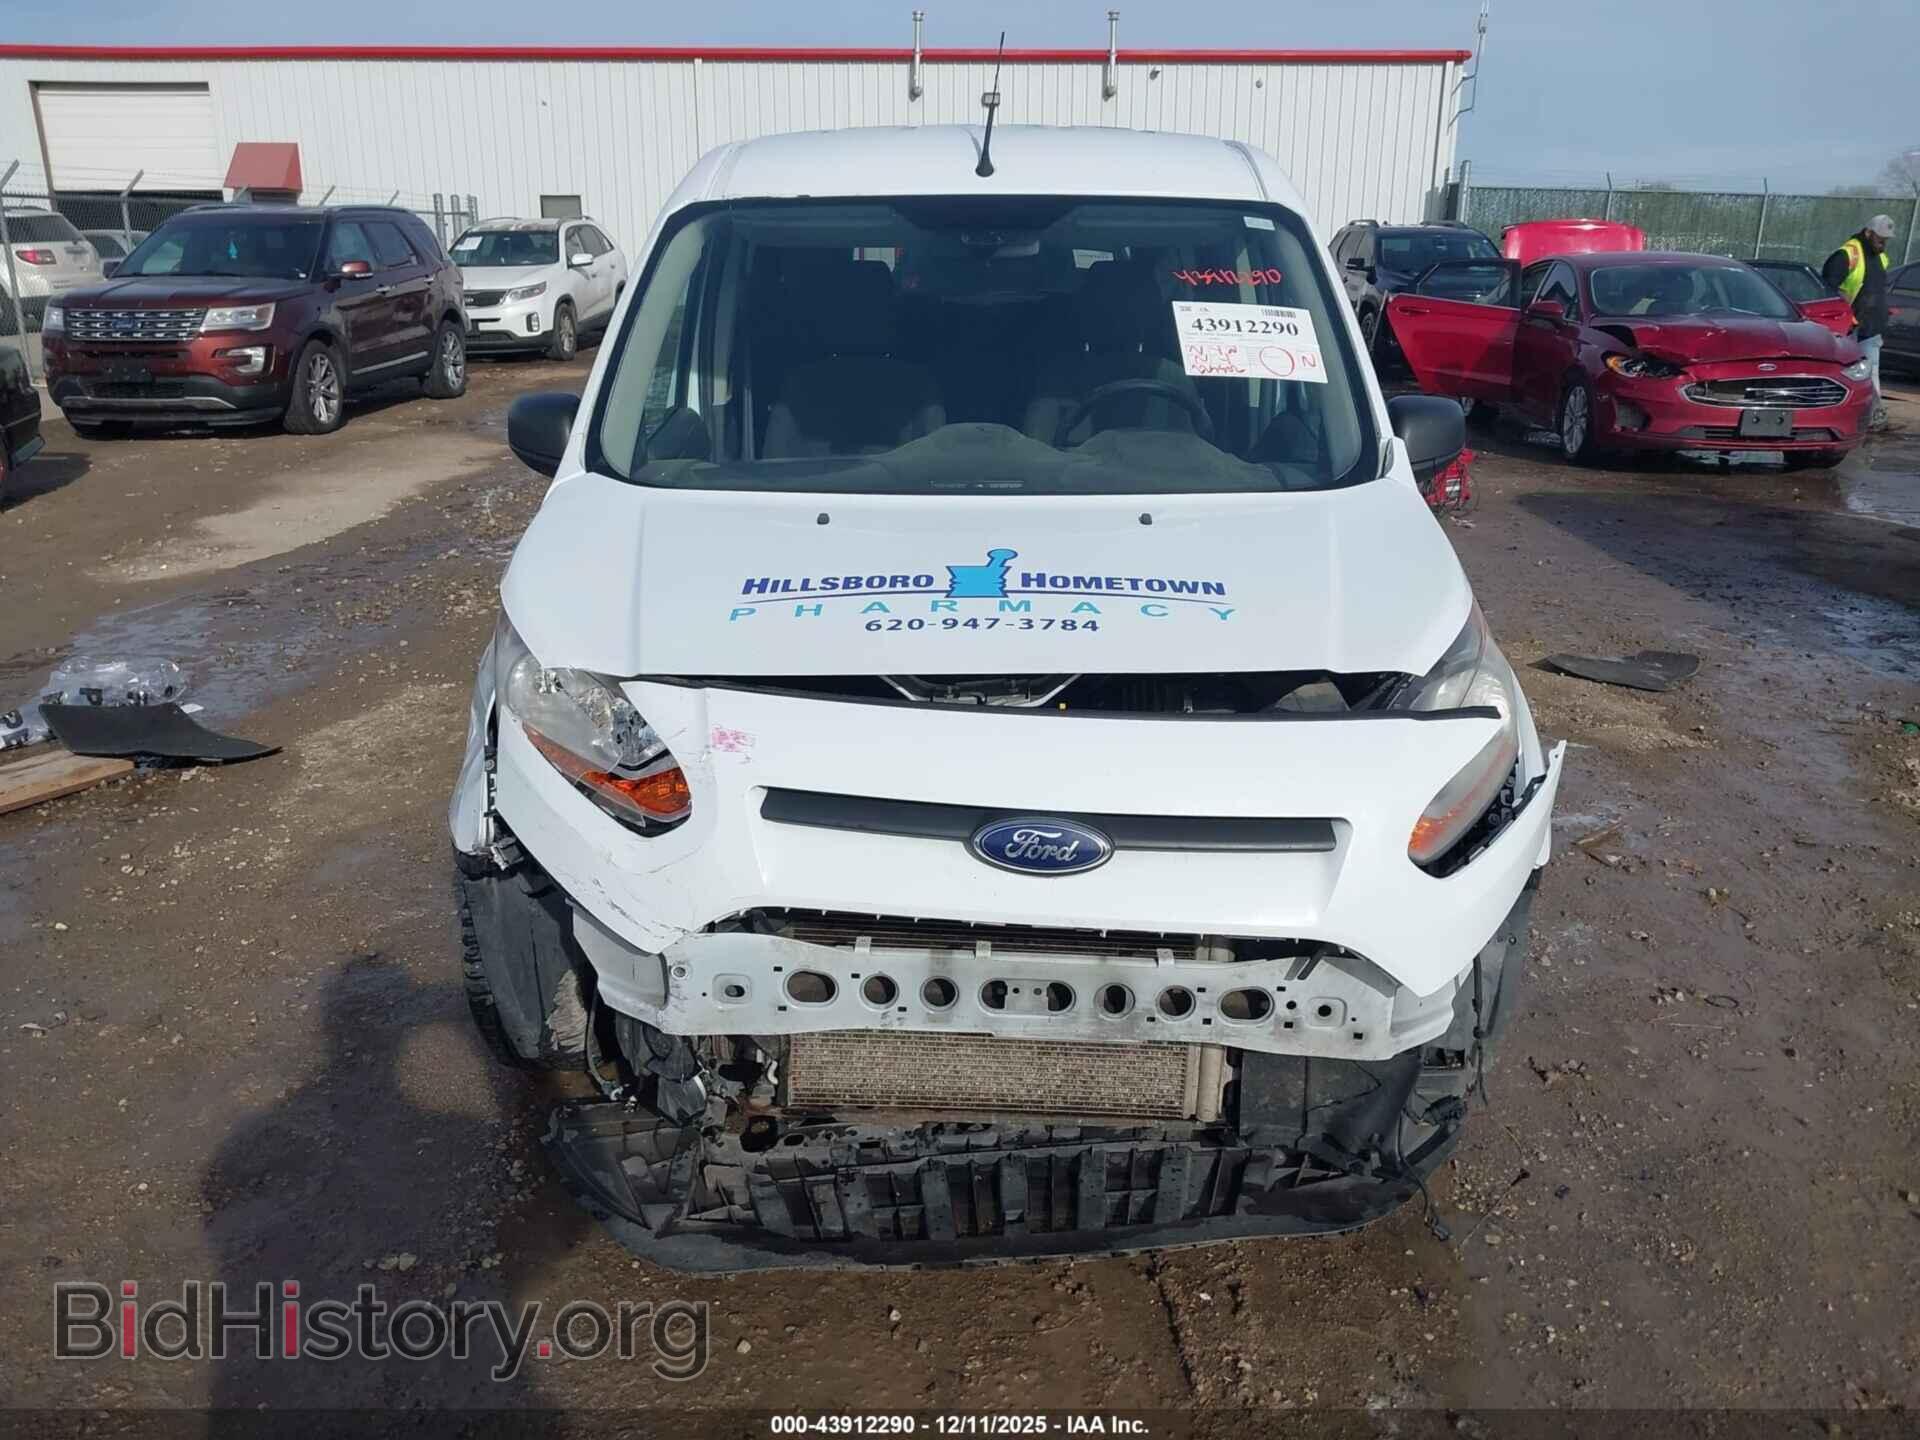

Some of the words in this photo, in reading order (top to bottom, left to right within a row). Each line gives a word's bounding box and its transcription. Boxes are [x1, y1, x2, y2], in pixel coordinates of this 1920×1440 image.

[1192, 317, 1299, 336] 43912290
[742, 574, 935, 595] HILLSBORO
[1020, 572, 1226, 596] HOMETOWN
[729, 599, 1236, 622] PHARMACY
[864, 617, 1100, 632] 620-947-3784
[1005, 829, 1080, 862] Ford
